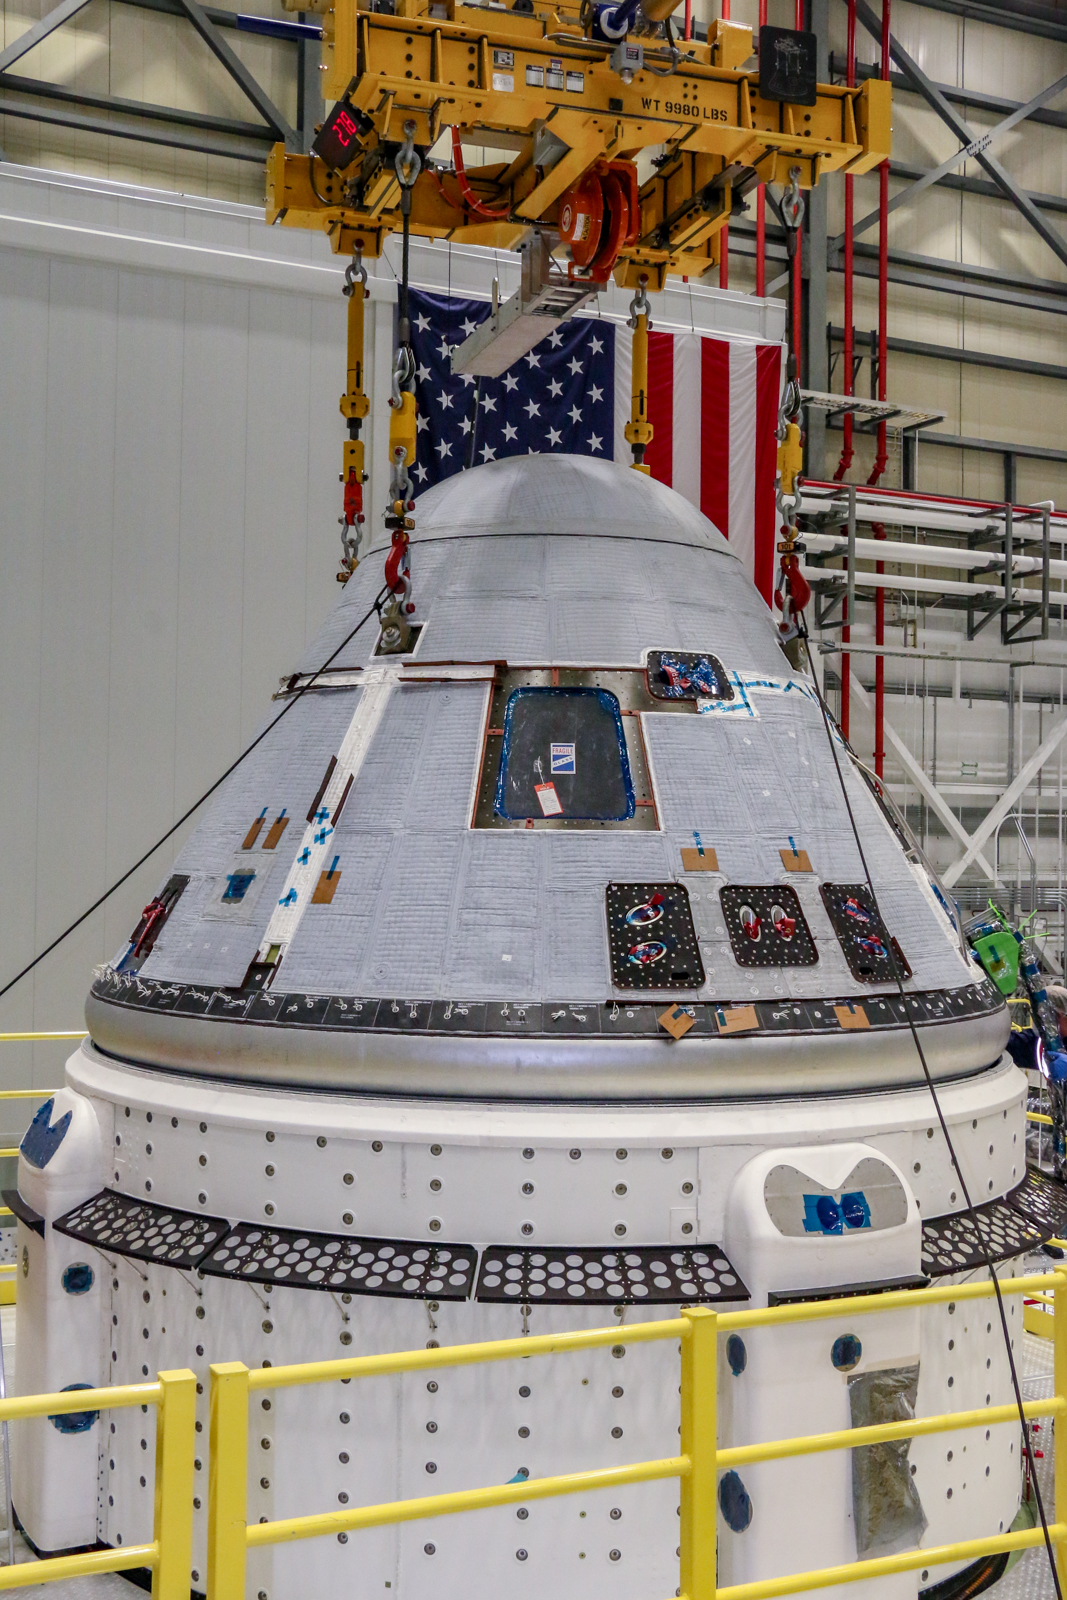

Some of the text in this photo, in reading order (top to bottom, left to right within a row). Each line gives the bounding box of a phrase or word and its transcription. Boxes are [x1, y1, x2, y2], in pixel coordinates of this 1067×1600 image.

[641, 97, 728, 122] WT 9980 LBS
[332, 110, 357, 147] 278
